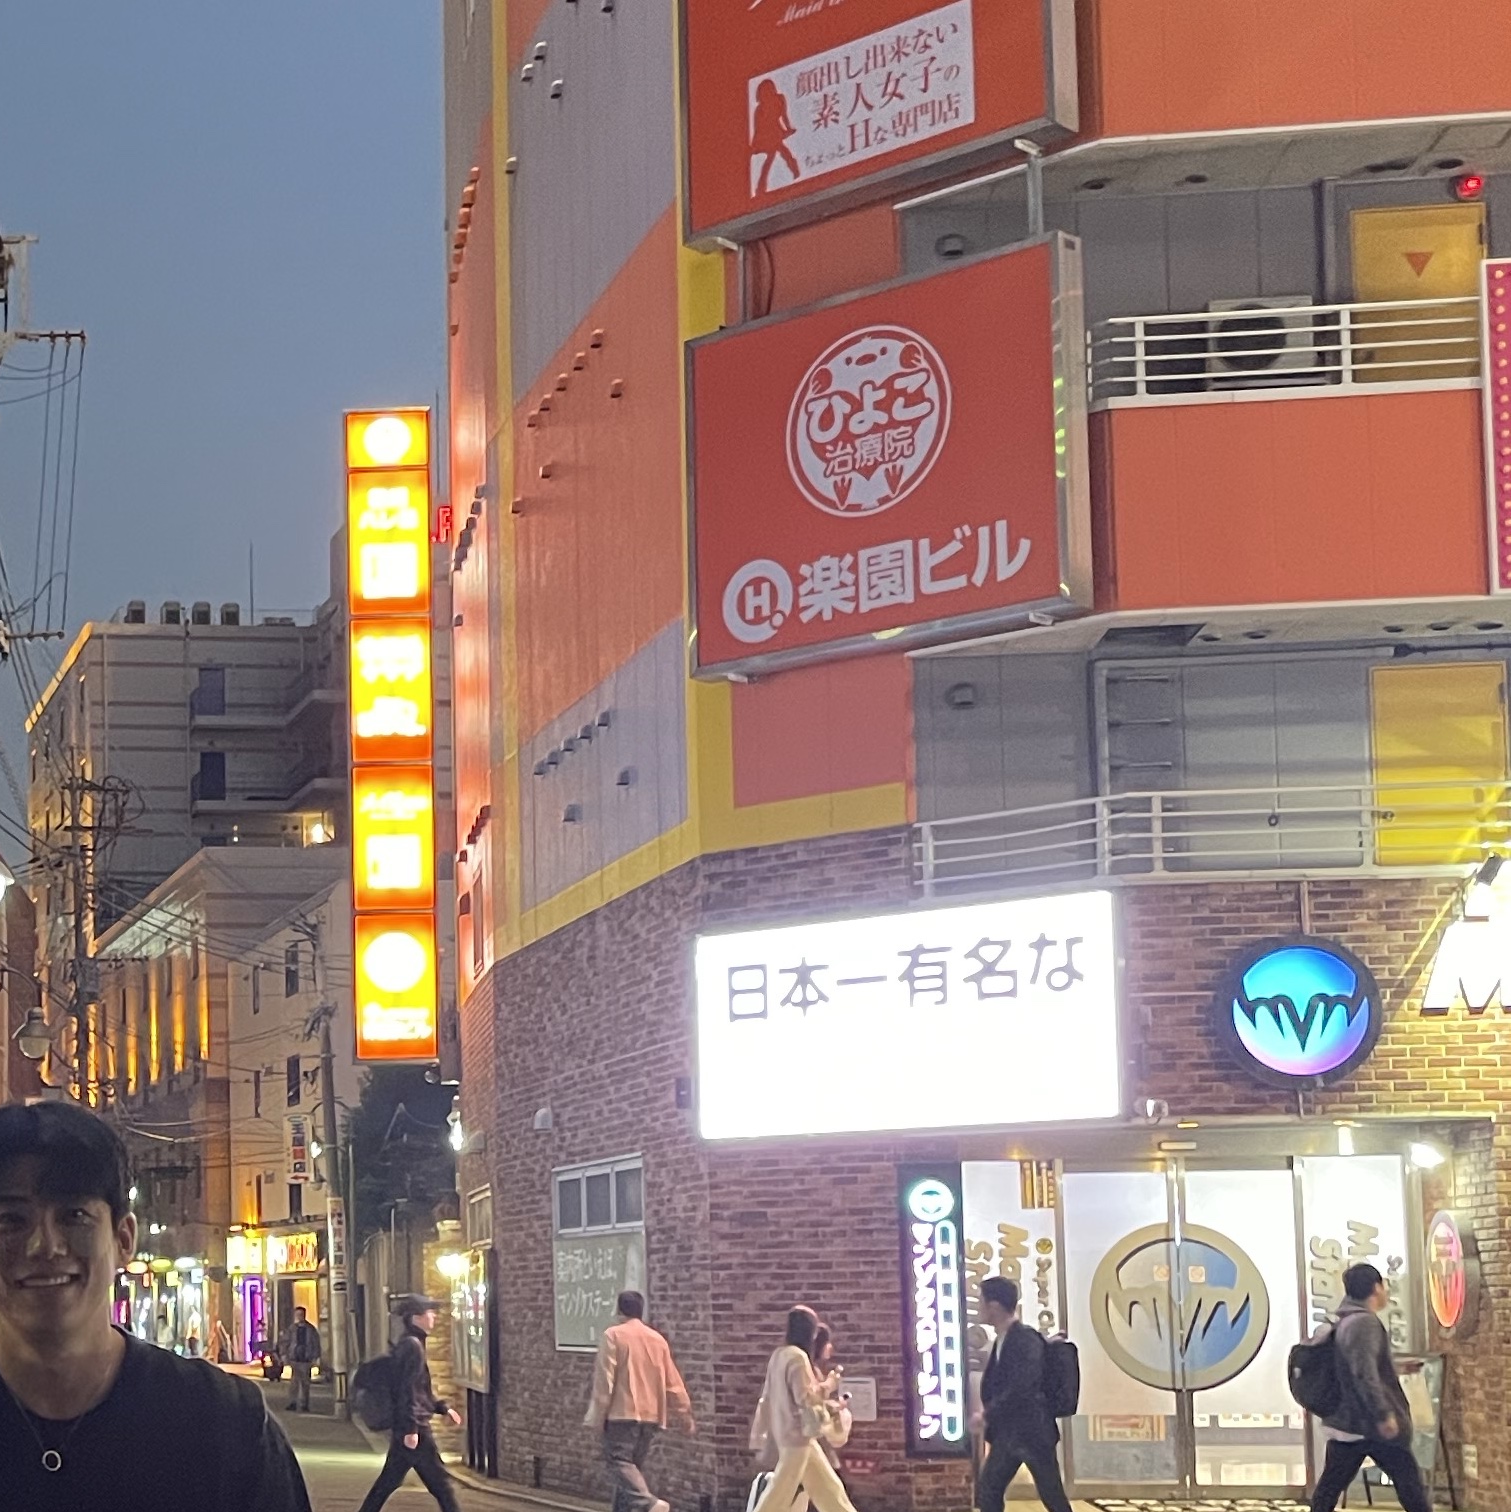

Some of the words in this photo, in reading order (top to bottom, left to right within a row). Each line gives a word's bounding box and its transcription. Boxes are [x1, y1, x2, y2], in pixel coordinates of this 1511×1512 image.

[794, 22, 958, 97] 顔出し出来ない
[810, 56, 960, 132] 素人女子の
[807, 370, 933, 443] ひよこ
[824, 425, 914, 476] 治療院
[797, 519, 1032, 624] 楽園ビル
[727, 932, 1084, 1023] 日本一有名な
